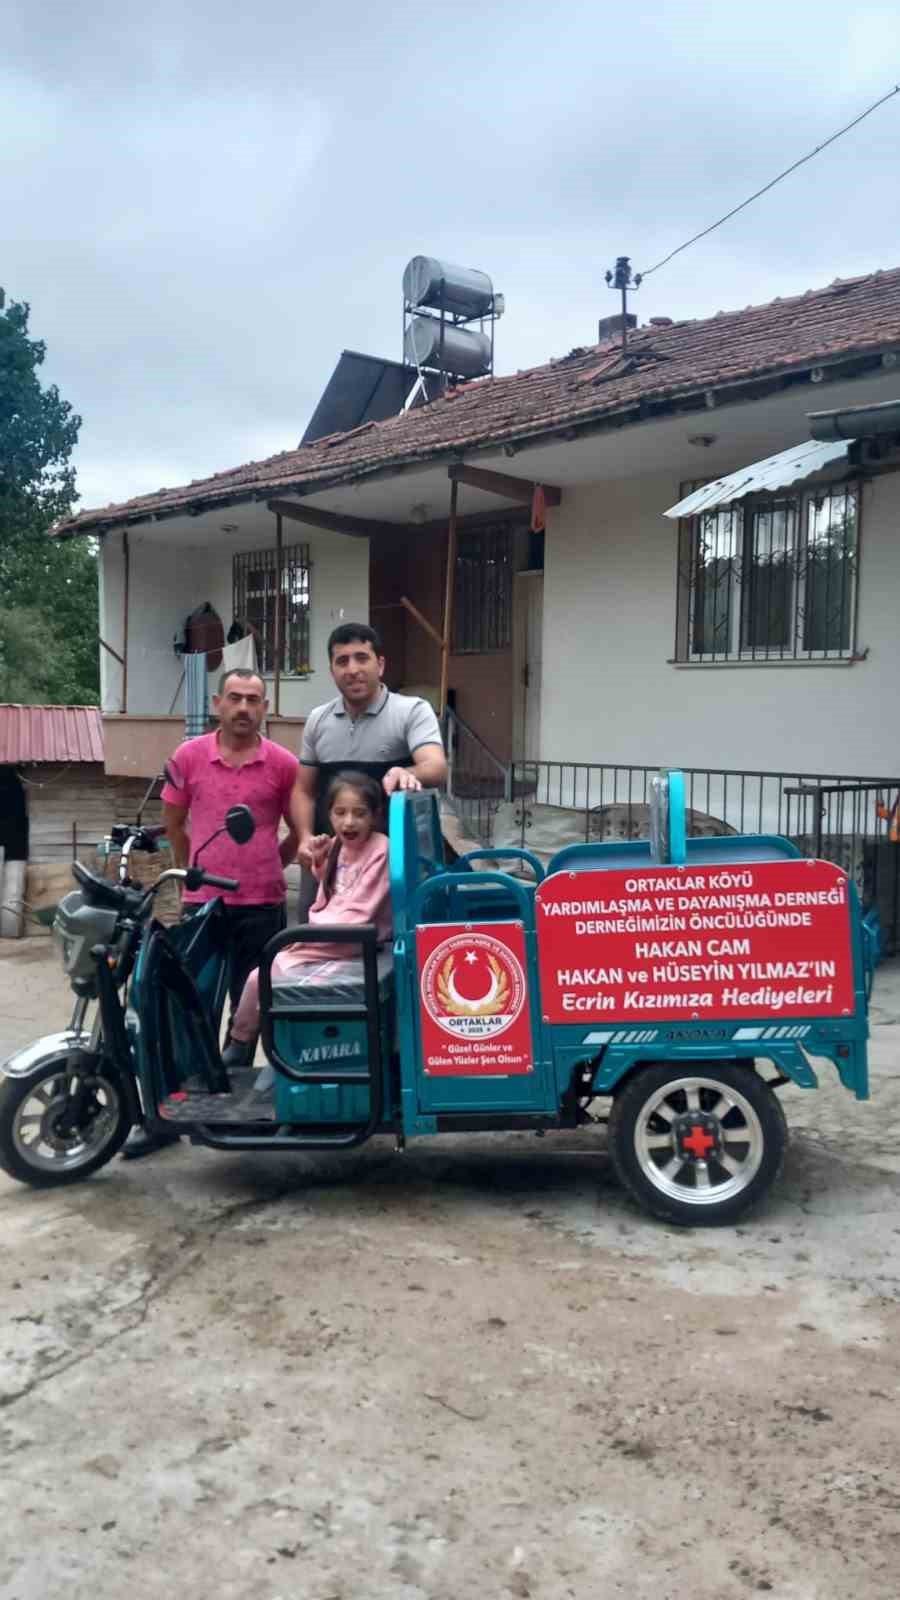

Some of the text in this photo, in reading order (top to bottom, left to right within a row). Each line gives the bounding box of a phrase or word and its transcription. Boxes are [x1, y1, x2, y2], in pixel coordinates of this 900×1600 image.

[626, 871, 752, 892] ORTAKLAR KÖYÜ
[542, 887, 844, 916] YARDIMLAŞMA VE DAYANIŞMA DERNEĞİ
[576, 909, 811, 934] DERNEĞİMİZİN ÖNCÜLÜĞÜNDE
[636, 939, 750, 958] HAKAN CAM
[558, 968, 623, 985] HAKAN
[627, 971, 648, 982] ve
[653, 960, 733, 982] HÜSEYİN
[563, 985, 832, 1010] Ecrin Kızımıza Hediyeleri
[449, 1017, 502, 1027] ORTAKLAR
[299, 1041, 361, 1063] NAVARA
[448, 1044, 472, 1053] Güzel
